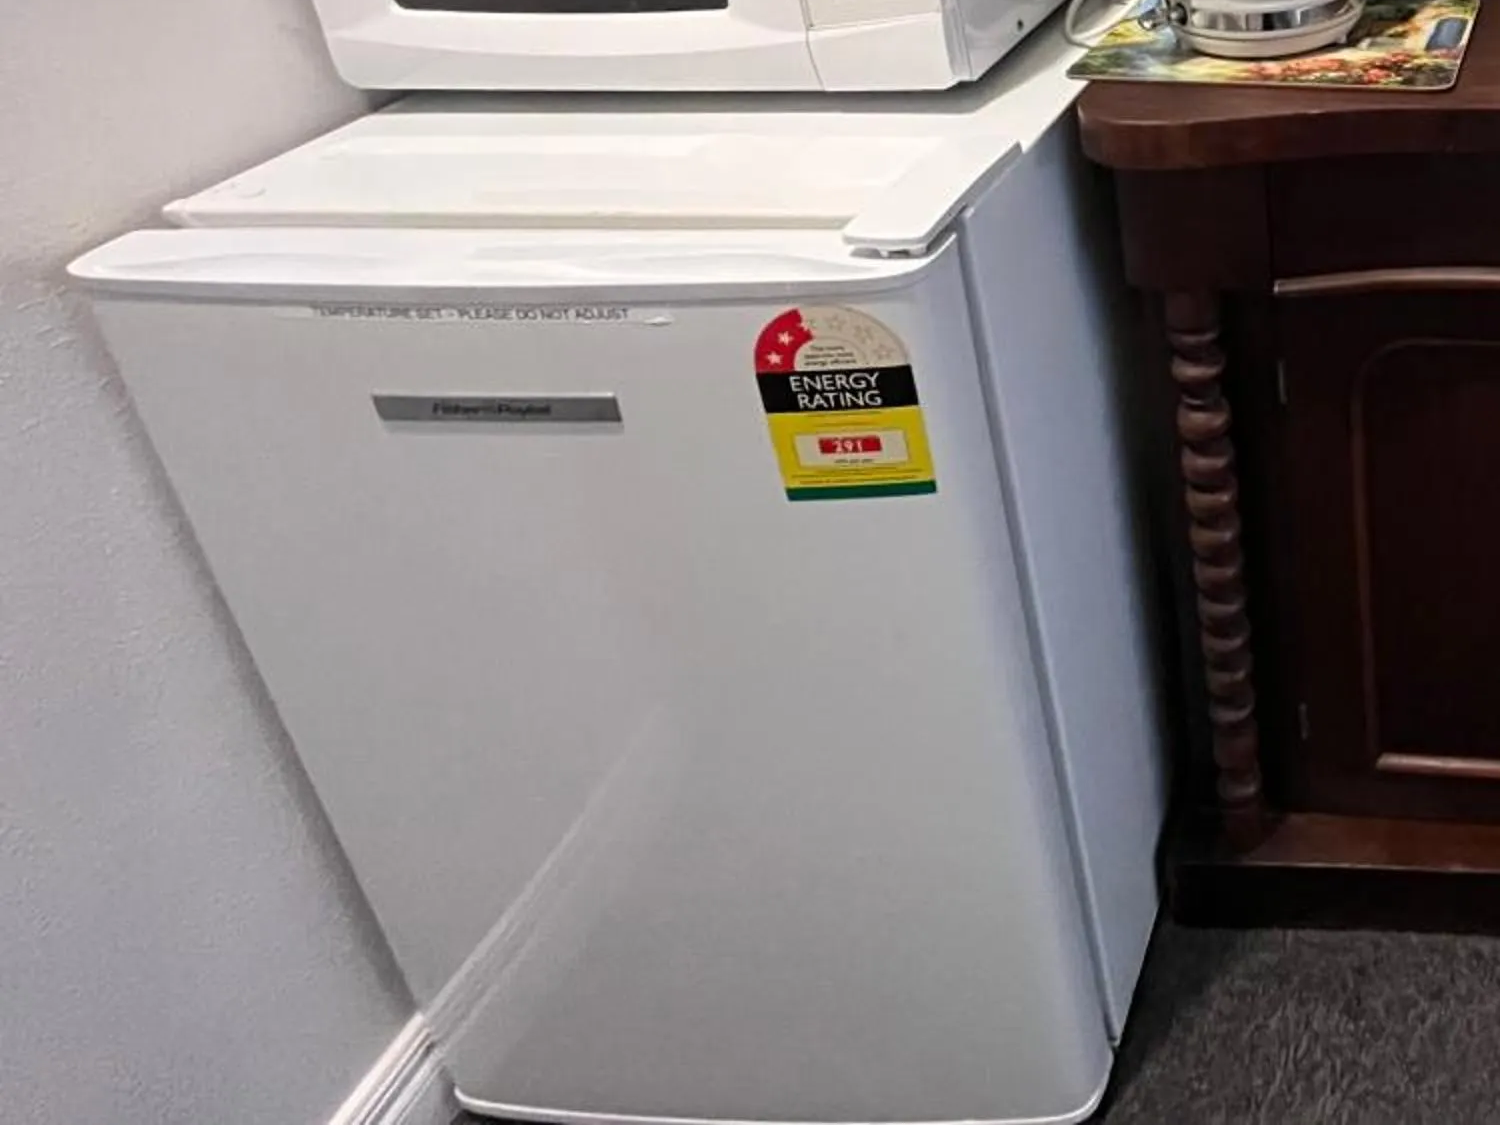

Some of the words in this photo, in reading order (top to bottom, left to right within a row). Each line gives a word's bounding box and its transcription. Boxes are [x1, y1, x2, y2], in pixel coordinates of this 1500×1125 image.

[515, 307, 537, 321] DO
[788, 372, 880, 393] ENERGY
[797, 390, 883, 410] RATING
[831, 438, 863, 453] 291
